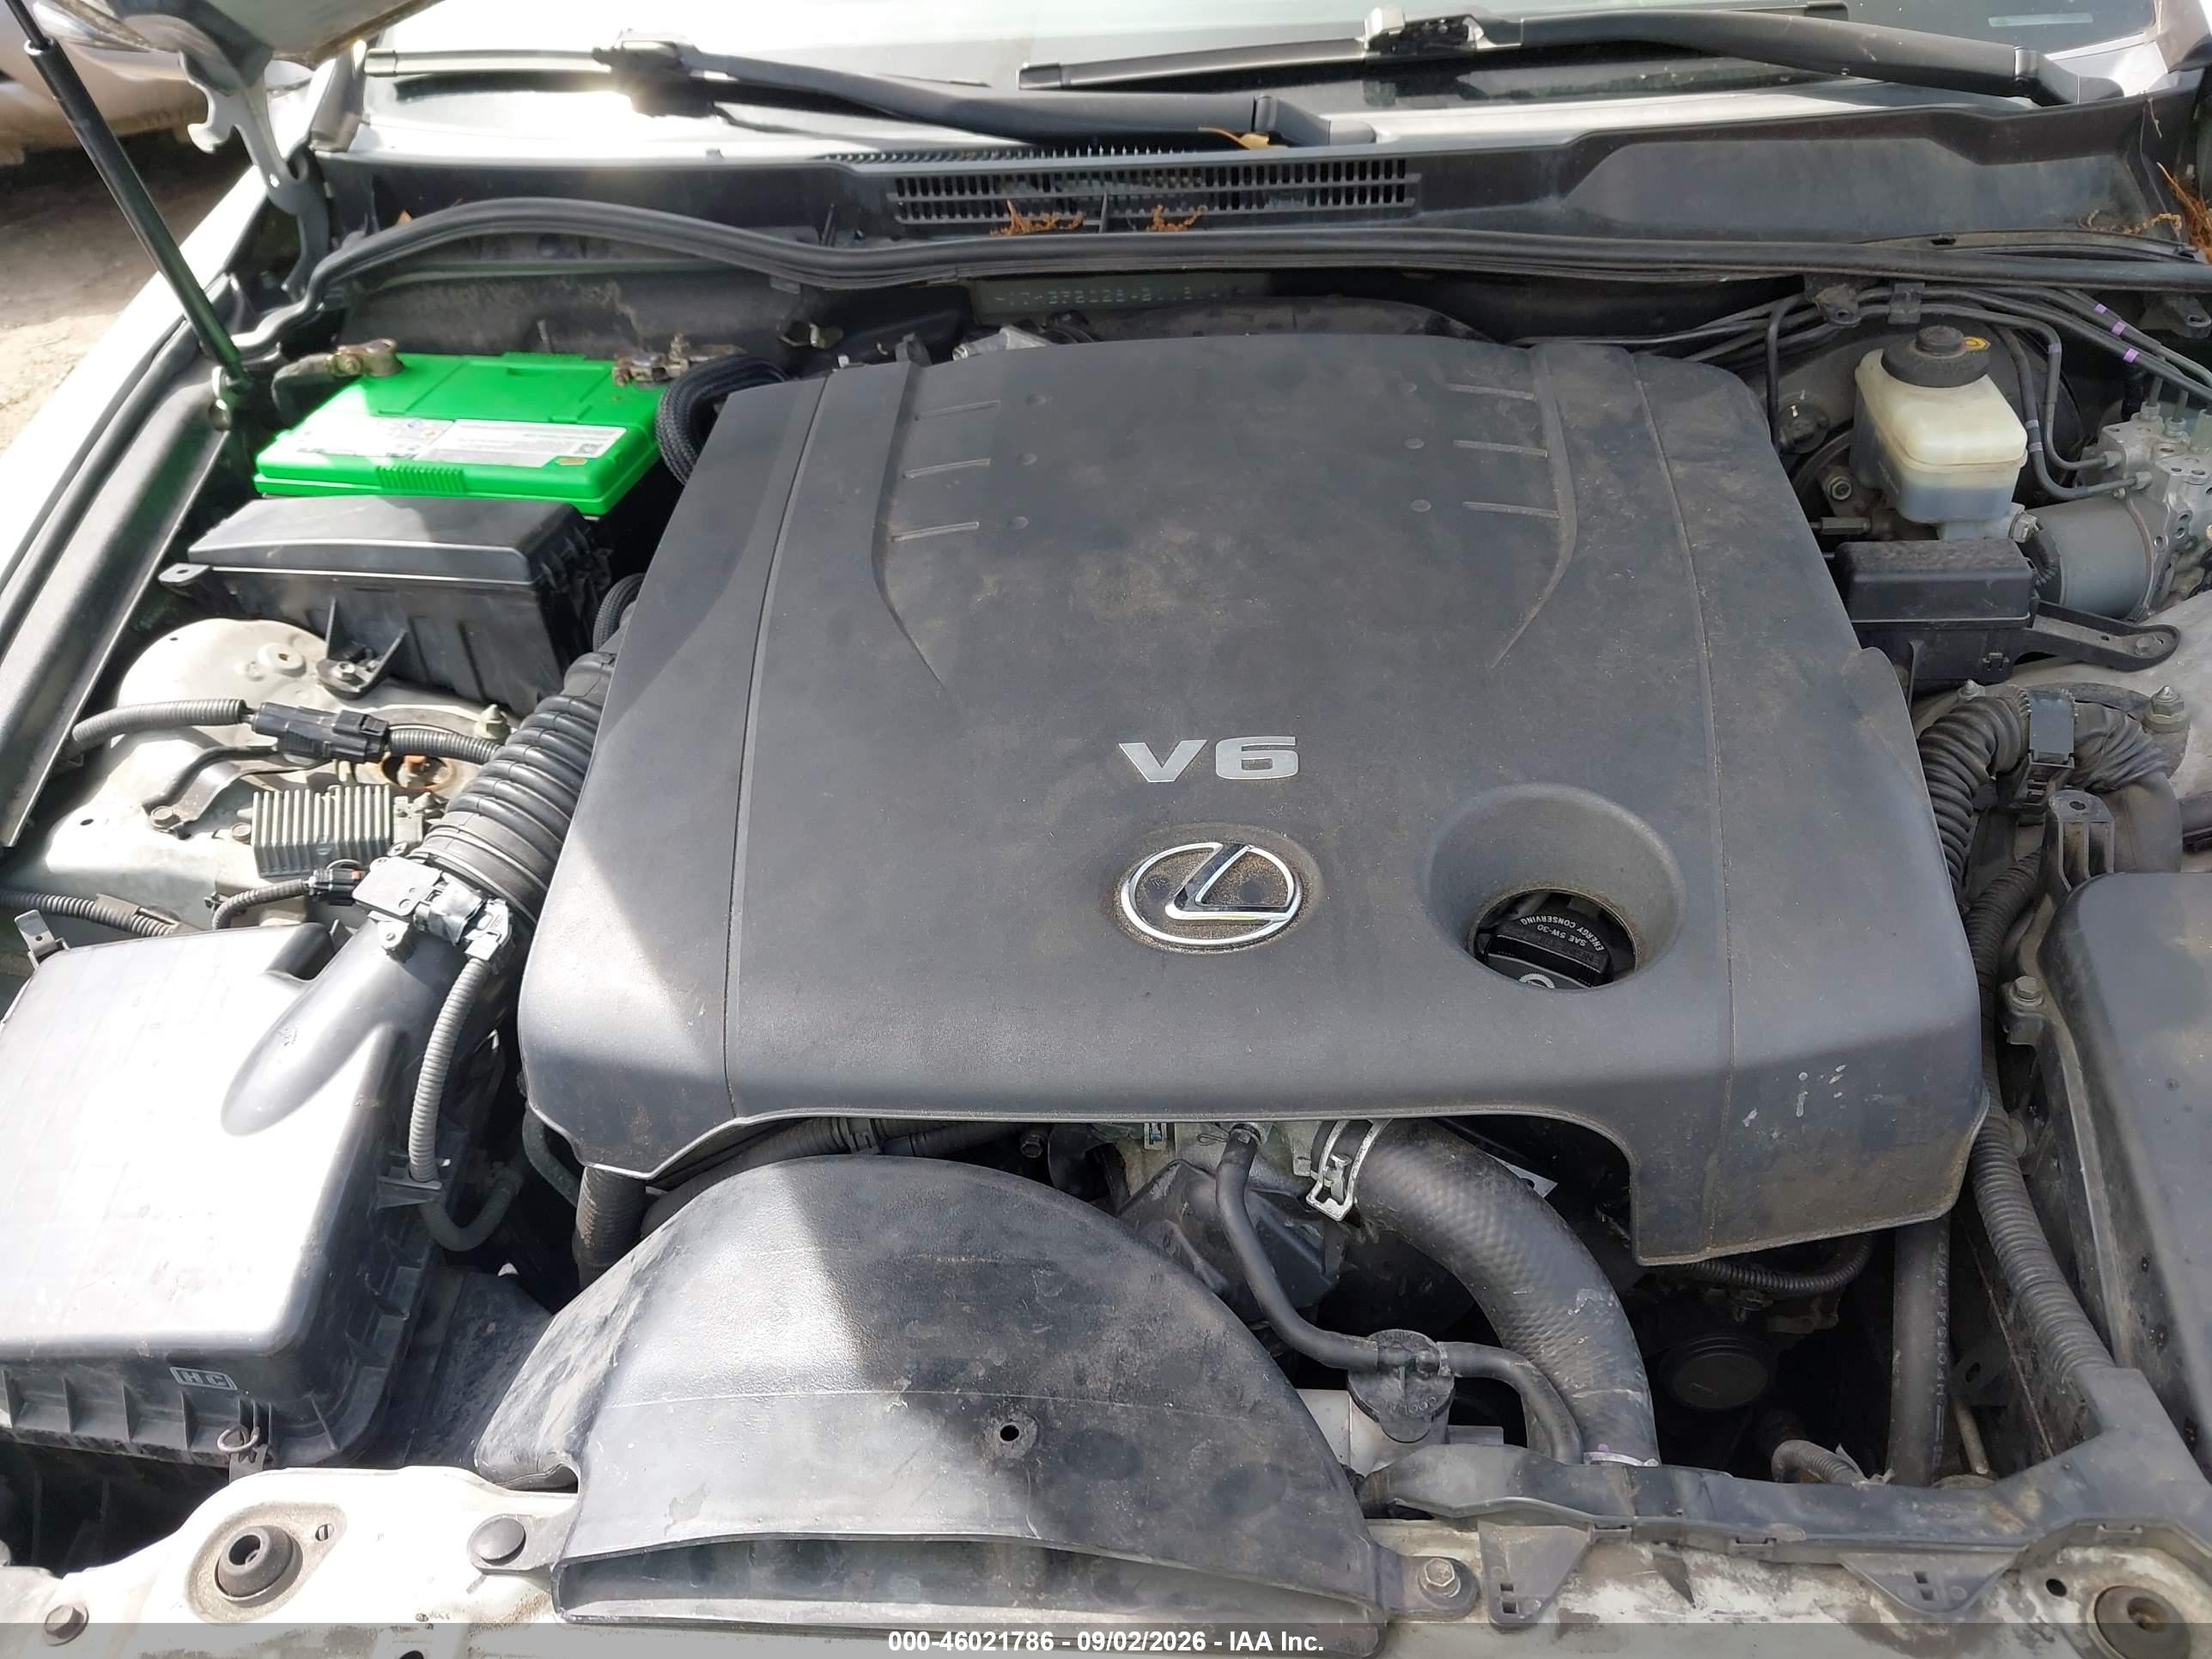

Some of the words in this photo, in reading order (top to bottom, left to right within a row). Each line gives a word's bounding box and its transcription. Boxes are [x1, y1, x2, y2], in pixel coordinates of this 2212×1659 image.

[1117, 735, 1299, 783] V6
[1520, 915, 1577, 928] CONSERVING
[1537, 924, 1567, 939] 5W-30
[1577, 927, 1606, 951] ENERGY
[1568, 935, 1588, 947] SAE
